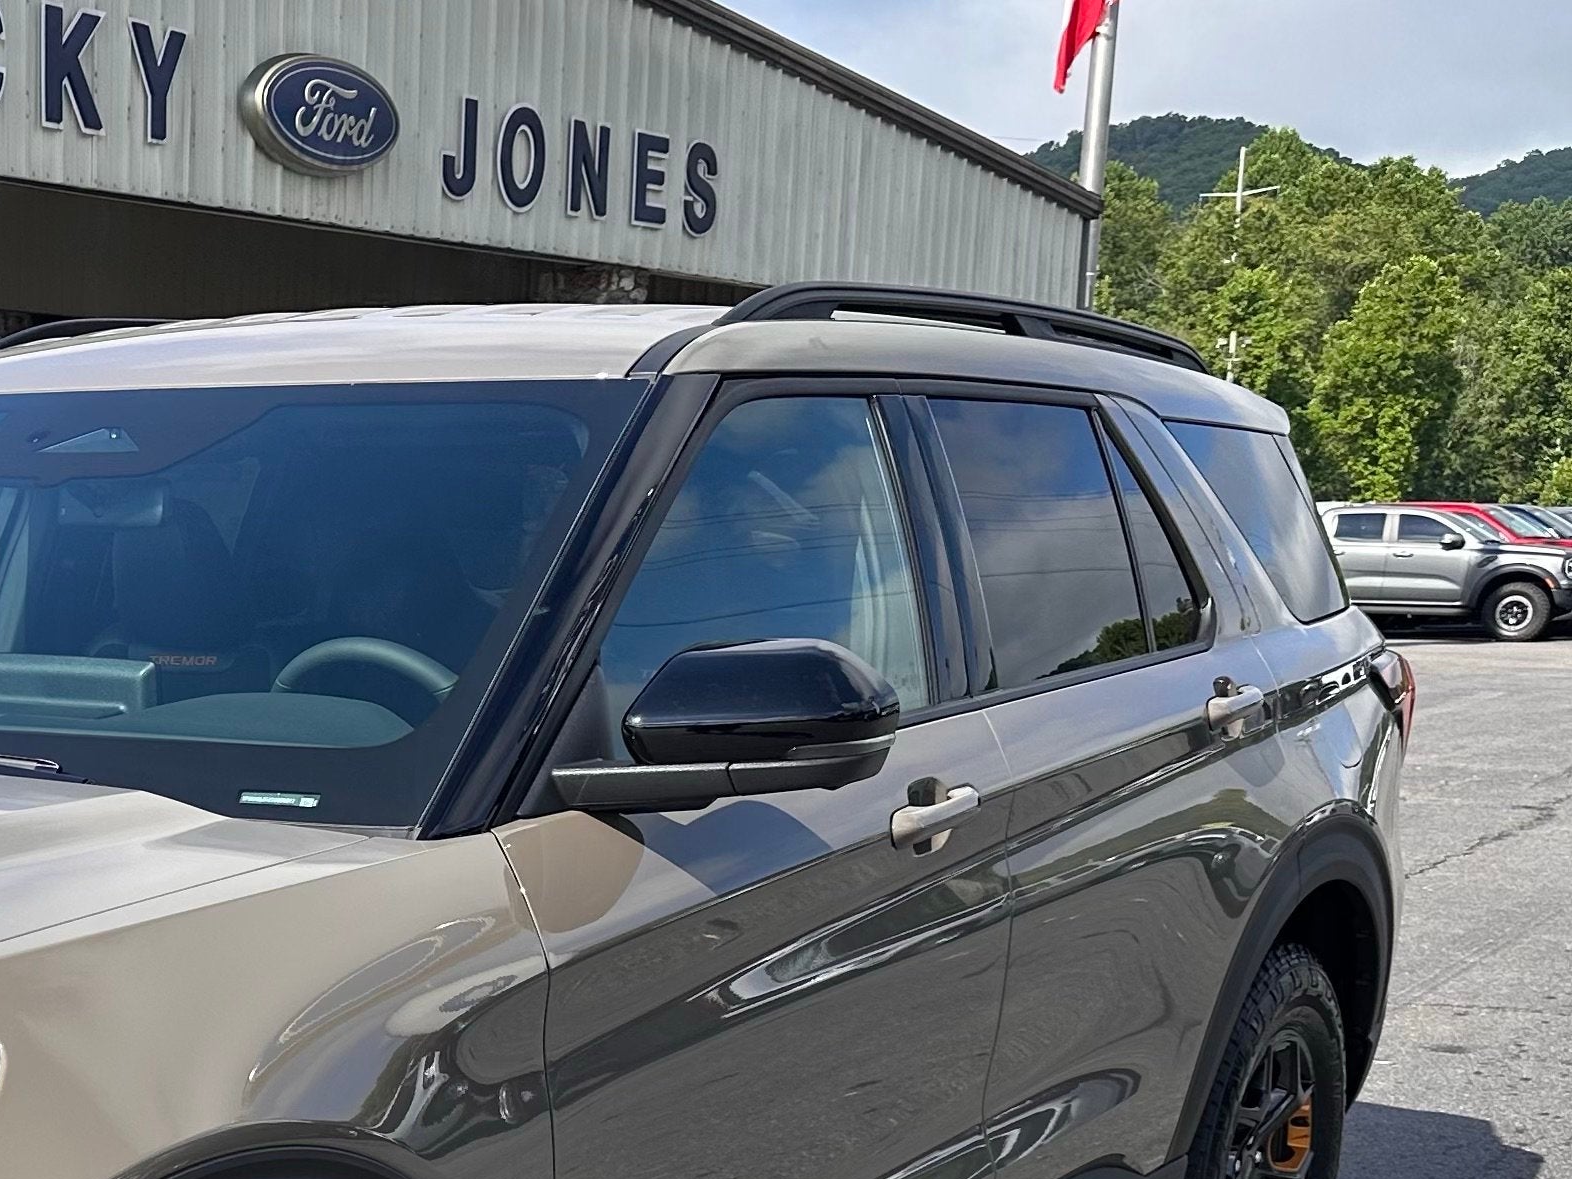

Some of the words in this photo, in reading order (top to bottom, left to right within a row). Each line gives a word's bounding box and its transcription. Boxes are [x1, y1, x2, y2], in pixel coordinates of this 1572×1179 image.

[295, 79, 377, 148] Ford
[441, 96, 718, 238] JONES
[149, 655, 218, 666] TREMOR
